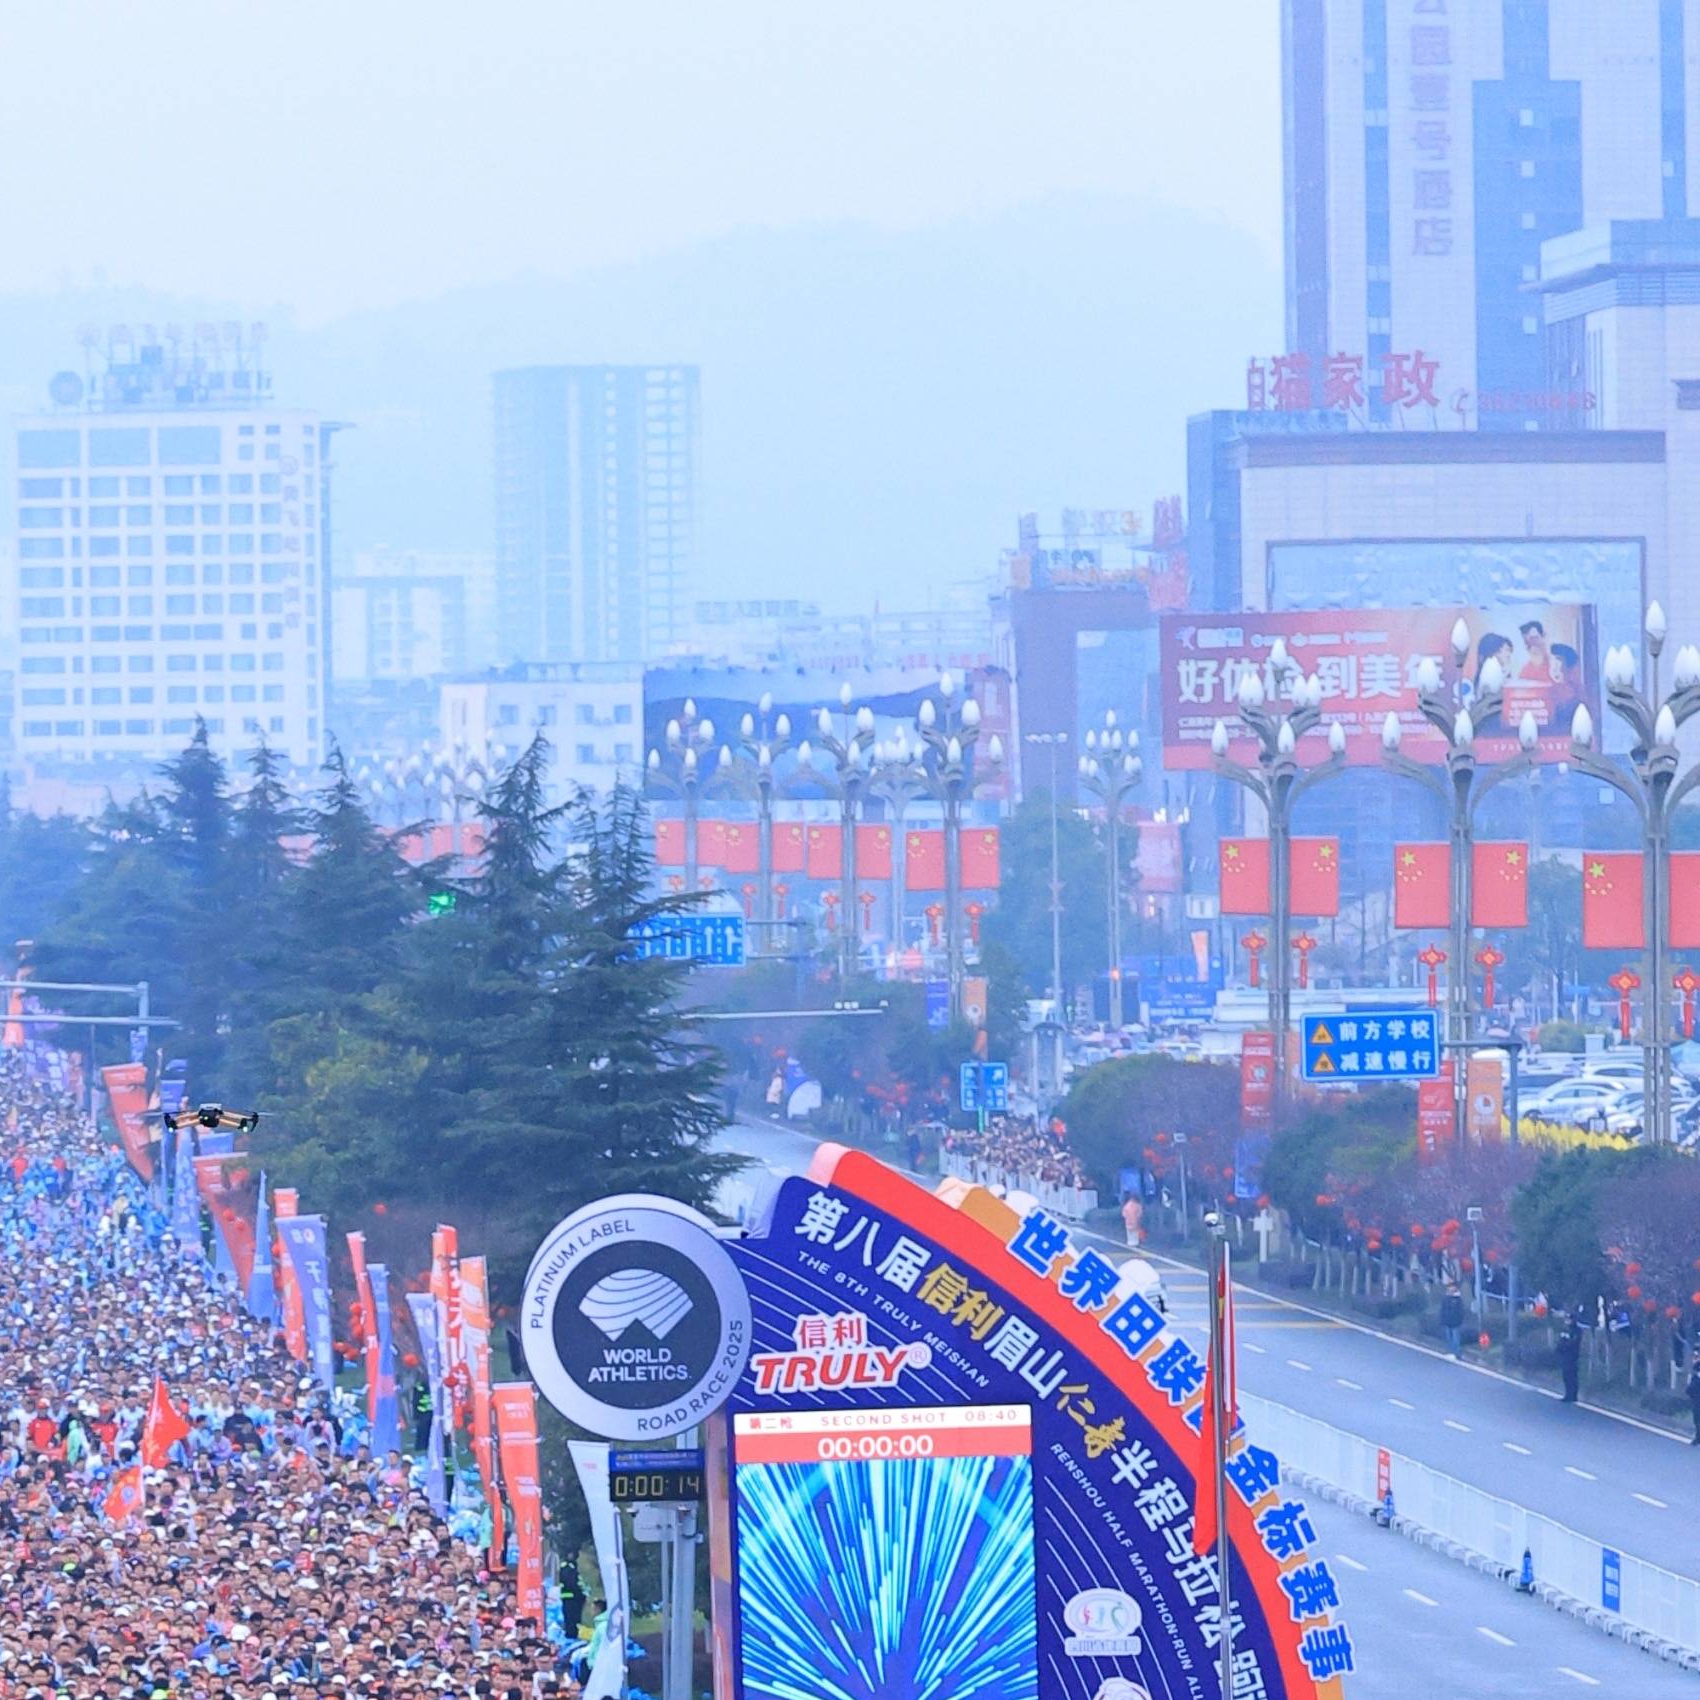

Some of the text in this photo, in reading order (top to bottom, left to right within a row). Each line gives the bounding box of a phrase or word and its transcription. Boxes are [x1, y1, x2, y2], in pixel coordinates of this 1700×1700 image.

[1339, 1019, 1432, 1042] 前方学校
[1339, 1050, 1432, 1073] 减速慢行
[531, 1218, 636, 1330] PLATINUM LABEL
[797, 1251, 991, 1389] THE 8TH TRULY MEISHAN
[800, 1318, 865, 1351] 信利
[603, 1348, 672, 1365] WORLD
[636, 1407, 690, 1433] ROAD
[690, 1367, 729, 1416] RACE
[724, 1319, 745, 1368] 2025
[820, 1409, 1018, 1427] SECOND SHOT 08:40
[817, 1436, 934, 1458] 00:00:00
[1005, 1208, 1354, 1682] 世界田联金标赛事
[1050, 1443, 1106, 1511] RENSHOU
[1103, 1511, 1135, 1549] HALF
